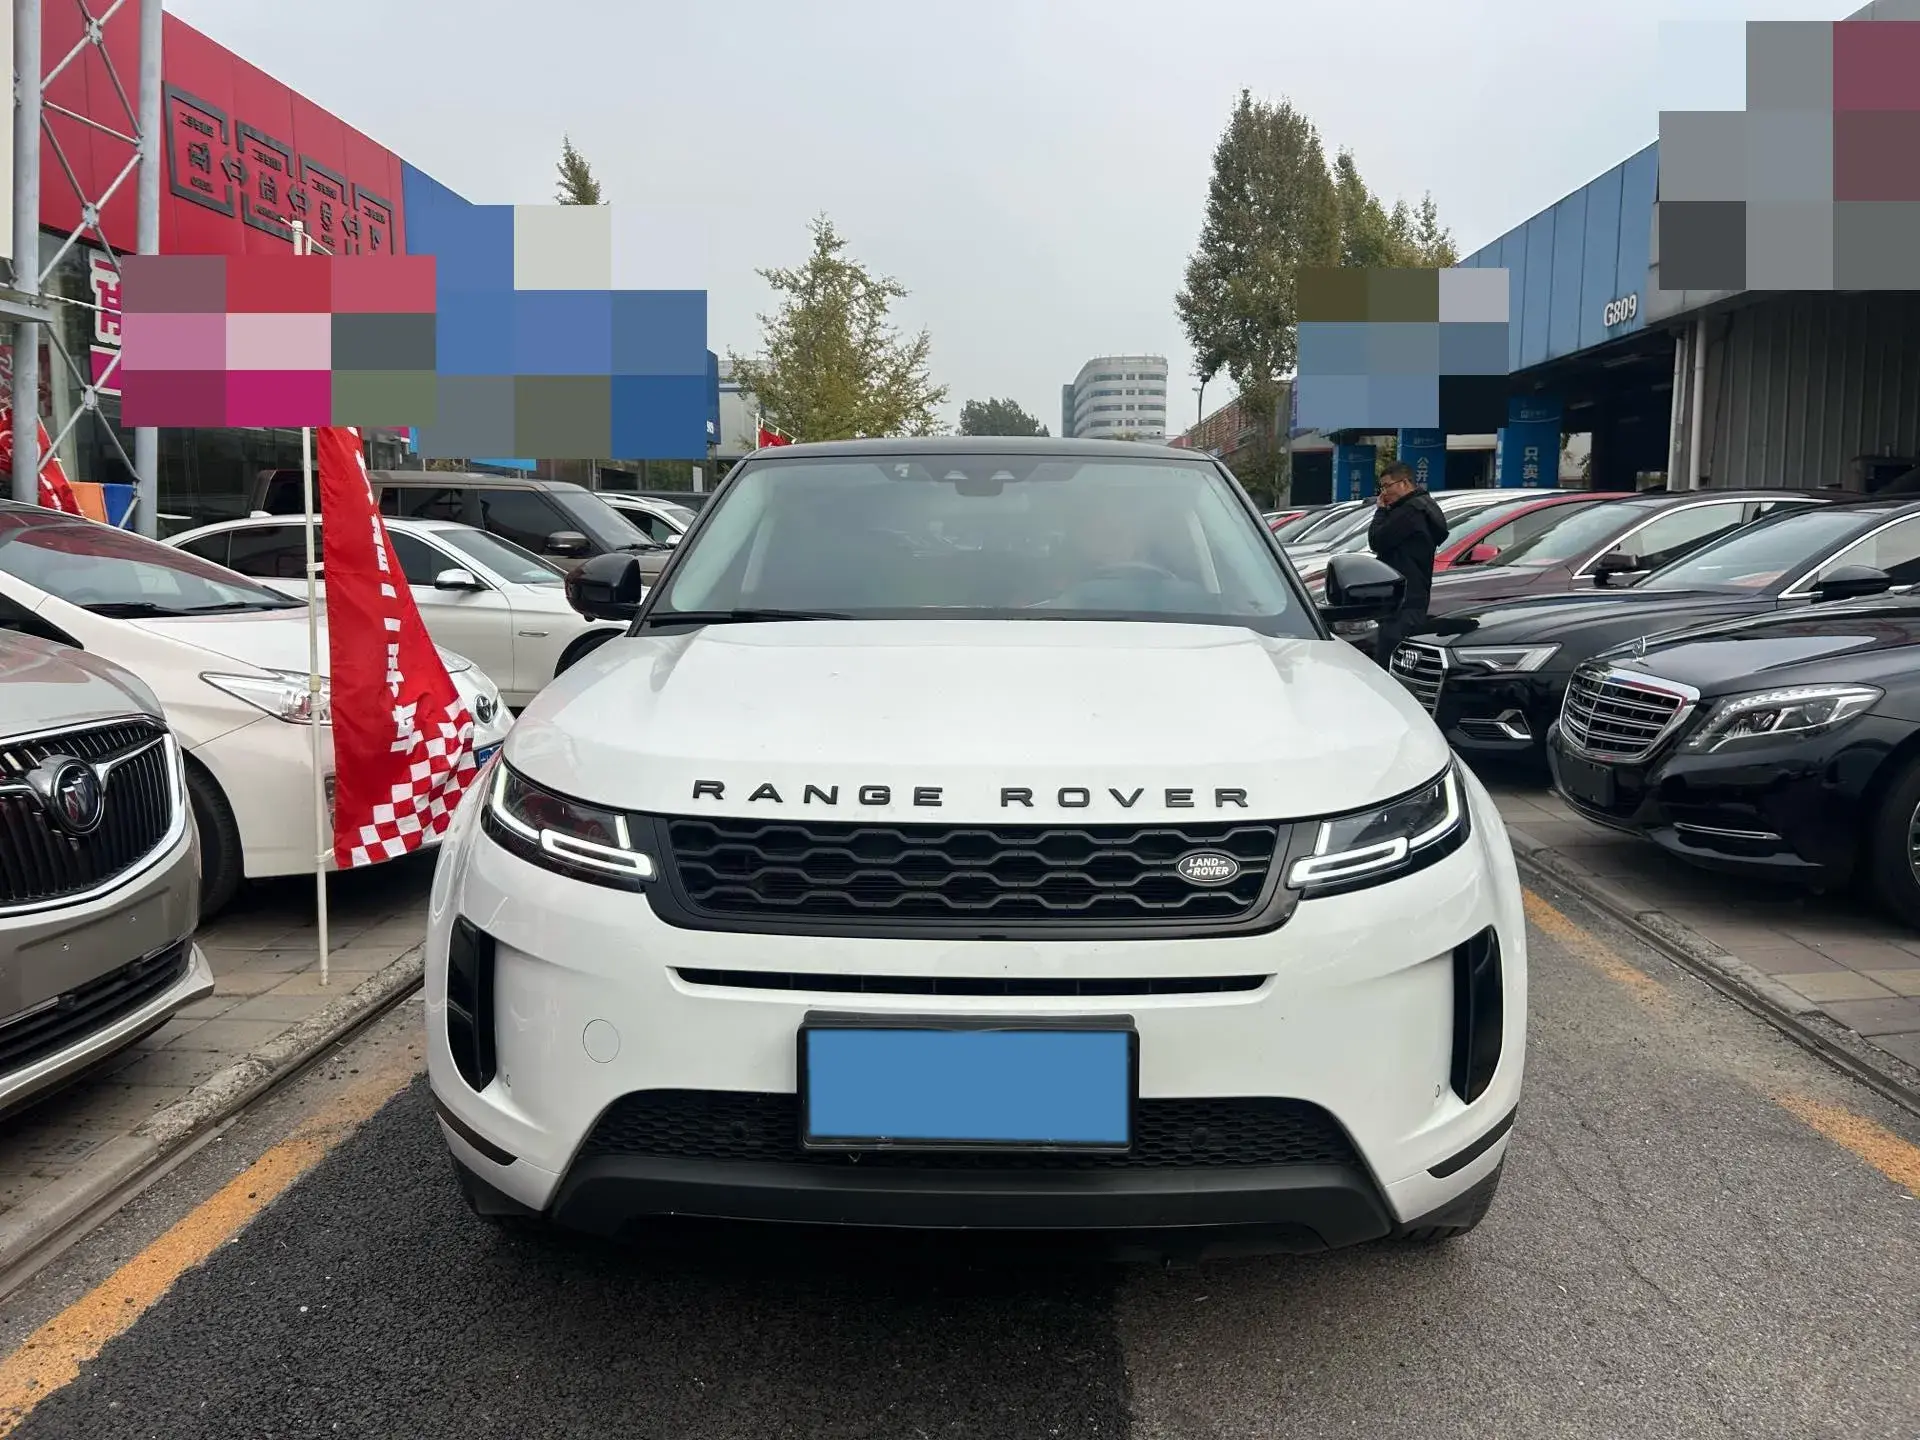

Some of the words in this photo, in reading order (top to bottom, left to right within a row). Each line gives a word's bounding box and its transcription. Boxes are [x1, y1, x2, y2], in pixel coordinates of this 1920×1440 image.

[1604, 293, 1637, 327] G809
[692, 779, 944, 807] RANGE
[1000, 786, 1250, 808] ROVER
[1189, 857, 1219, 867] LAND
[1193, 866, 1229, 876] ROVER
